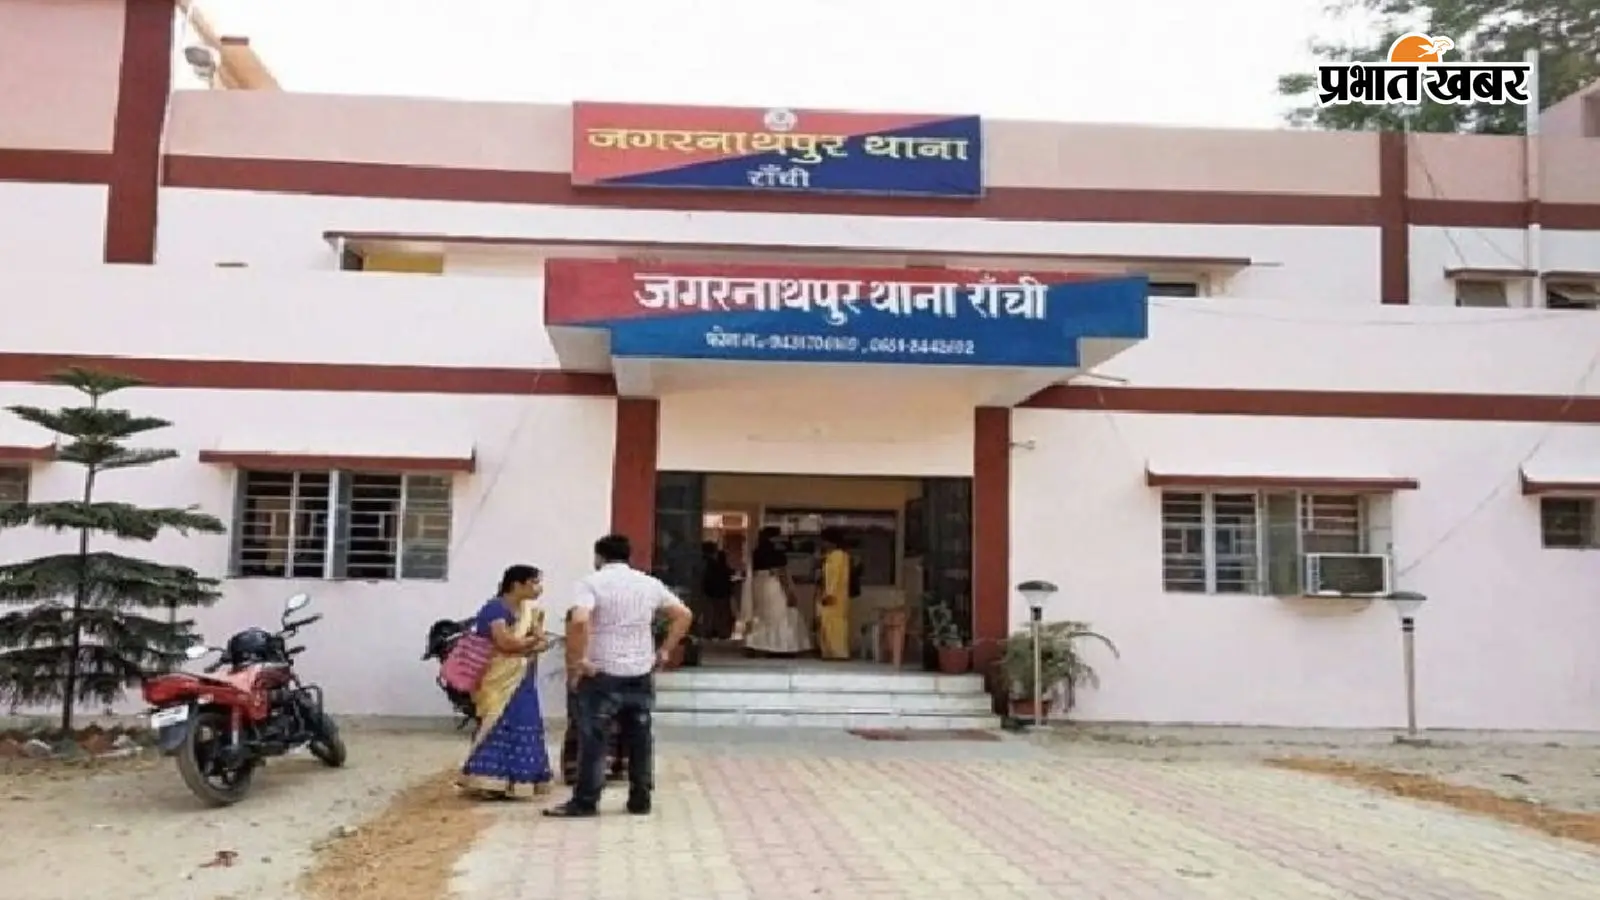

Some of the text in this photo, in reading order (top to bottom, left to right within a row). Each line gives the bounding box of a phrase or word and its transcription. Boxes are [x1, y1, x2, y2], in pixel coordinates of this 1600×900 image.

[587, 127, 970, 164] जगरनाथपुर थाना
[633, 271, 1050, 326] जगरनाथपुर थाना राँची
